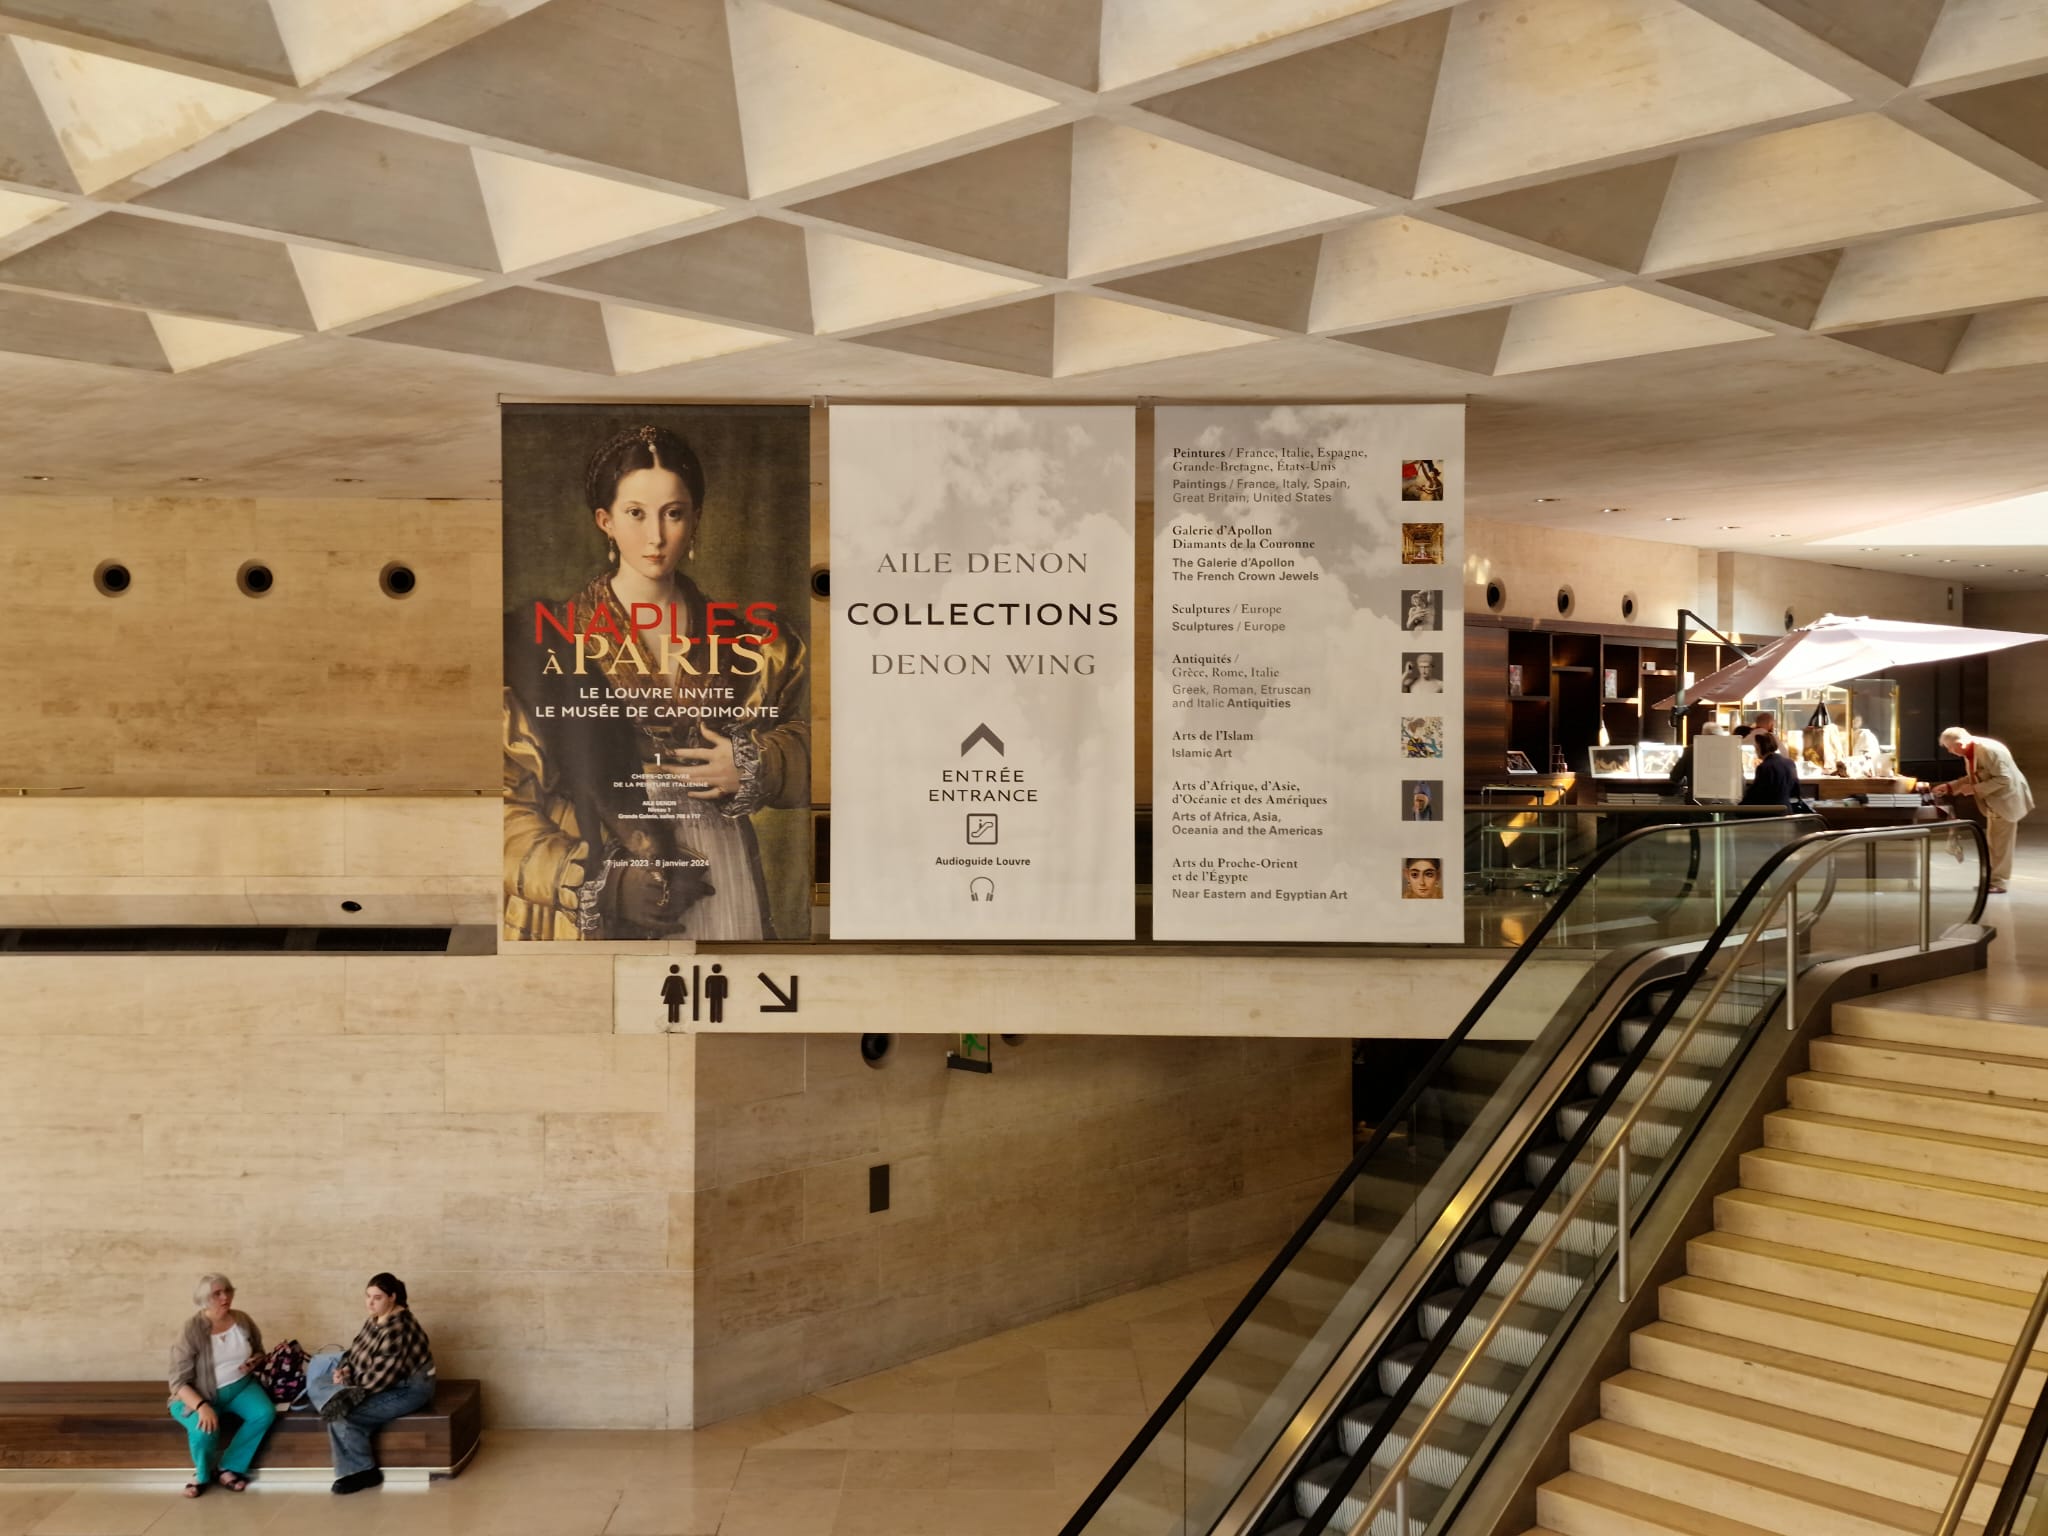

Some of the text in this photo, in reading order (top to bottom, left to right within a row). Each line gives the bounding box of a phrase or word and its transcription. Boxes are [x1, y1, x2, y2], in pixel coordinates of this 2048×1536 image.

[1173, 447, 1225, 457] Peintures
[1236, 447, 1278, 458] France,
[1281, 447, 1314, 458] Italie,
[1317, 447, 1368, 459] Espagne,
[1173, 460, 1336, 473] Grande-Bretagne, États-Unis
[1173, 479, 1227, 490] Paintings
[1237, 479, 1279, 489] France,
[1282, 479, 1310, 490] Italy,
[1314, 479, 1351, 490] Spain,
[1173, 492, 1332, 504] Great Britain, United States
[1172, 525, 1272, 537] Galerie d'Apollon
[1172, 538, 1315, 549] Diamants de la Couronne
[877, 552, 1088, 573] AILE DENON
[1173, 558, 1295, 569] The Galerie d'Apollon
[1173, 571, 1319, 582] The French Crown Jewels
[847, 602, 1118, 626] COLLECTIONS
[1172, 603, 1230, 615] Sculptures
[1241, 603, 1282, 615] Europe
[534, 602, 779, 645] NAPLES
[1172, 621, 1234, 633] Sculptures
[1244, 621, 1286, 633] Europe
[542, 632, 765, 676] À PARIS
[1172, 653, 1232, 665] Antiquités
[871, 654, 1096, 675] DENON WING
[1172, 667, 1279, 678] Grèce, Rome, Italie
[580, 687, 734, 700] LE LOUVRE INVITE
[1172, 685, 1311, 696] Greek, Roman, Etruscan
[1172, 698, 1291, 709] and Italic Antiquities
[535, 703, 779, 718] LE MUSÉE DE CAPODIMONTE
[1172, 731, 1254, 741] Arts de l'Islam
[1172, 748, 1232, 758] Islamic Art
[654, 753, 661, 766] 1
[943, 767, 1025, 782] ENTRÉE
[1172, 781, 1300, 793] Arts d'Afrique, d'Asie,
[929, 790, 1038, 802] ENTRANCE
[1172, 794, 1328, 806] d'Océanie et des Amériques
[1172, 811, 1281, 822] Arts of Africa, Asia,
[1172, 825, 1323, 836] Oceania and the Americas
[613, 859, 628, 868] juin
[662, 859, 690, 868] janvier
[936, 857, 1031, 867] Audioguide Louvre
[1172, 858, 1298, 869] Arts du Proche-Orient
[1172, 870, 1248, 883] et de l'Égypte
[1172, 889, 1348, 901] Near Eastern and Egyptian Art
